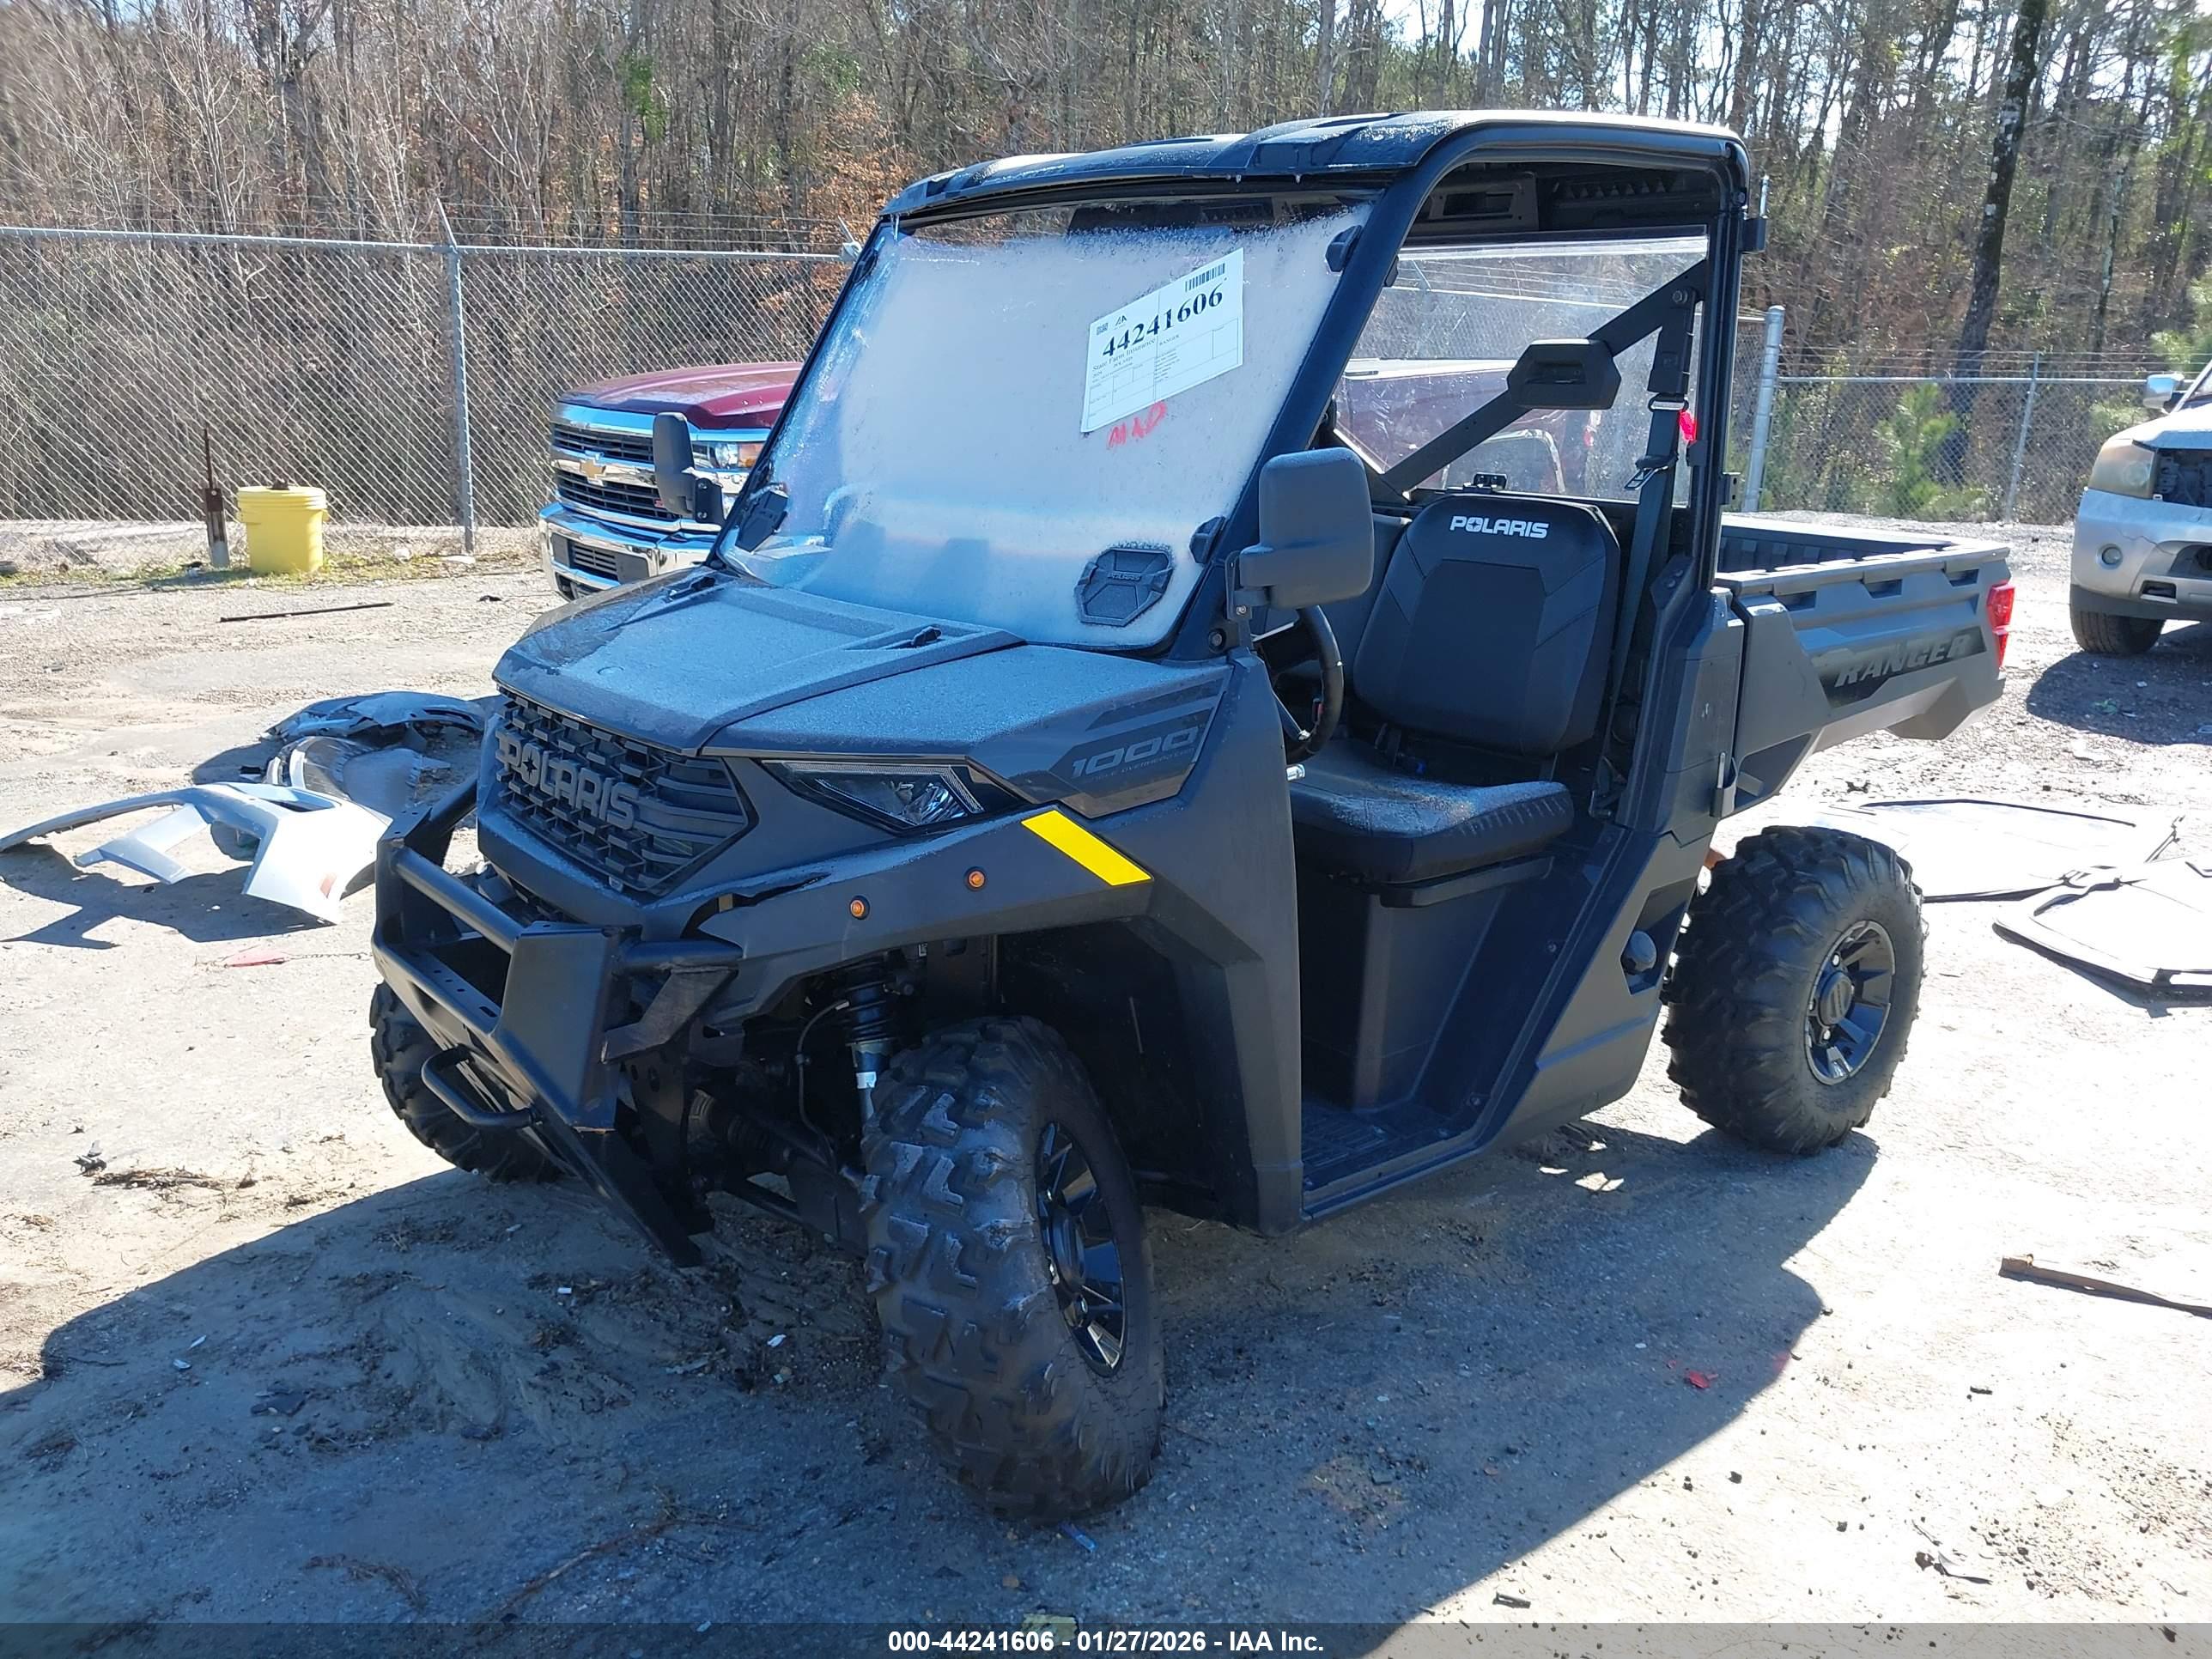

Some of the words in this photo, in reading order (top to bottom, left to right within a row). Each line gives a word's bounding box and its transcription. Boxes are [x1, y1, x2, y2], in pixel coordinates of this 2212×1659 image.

[1103, 283, 1223, 356] 44241606
[1449, 515, 1550, 539] POLARIS
[1834, 634, 1973, 688] RANGER
[1073, 726, 1200, 779] 1000
[495, 730, 640, 830] POLARIS
